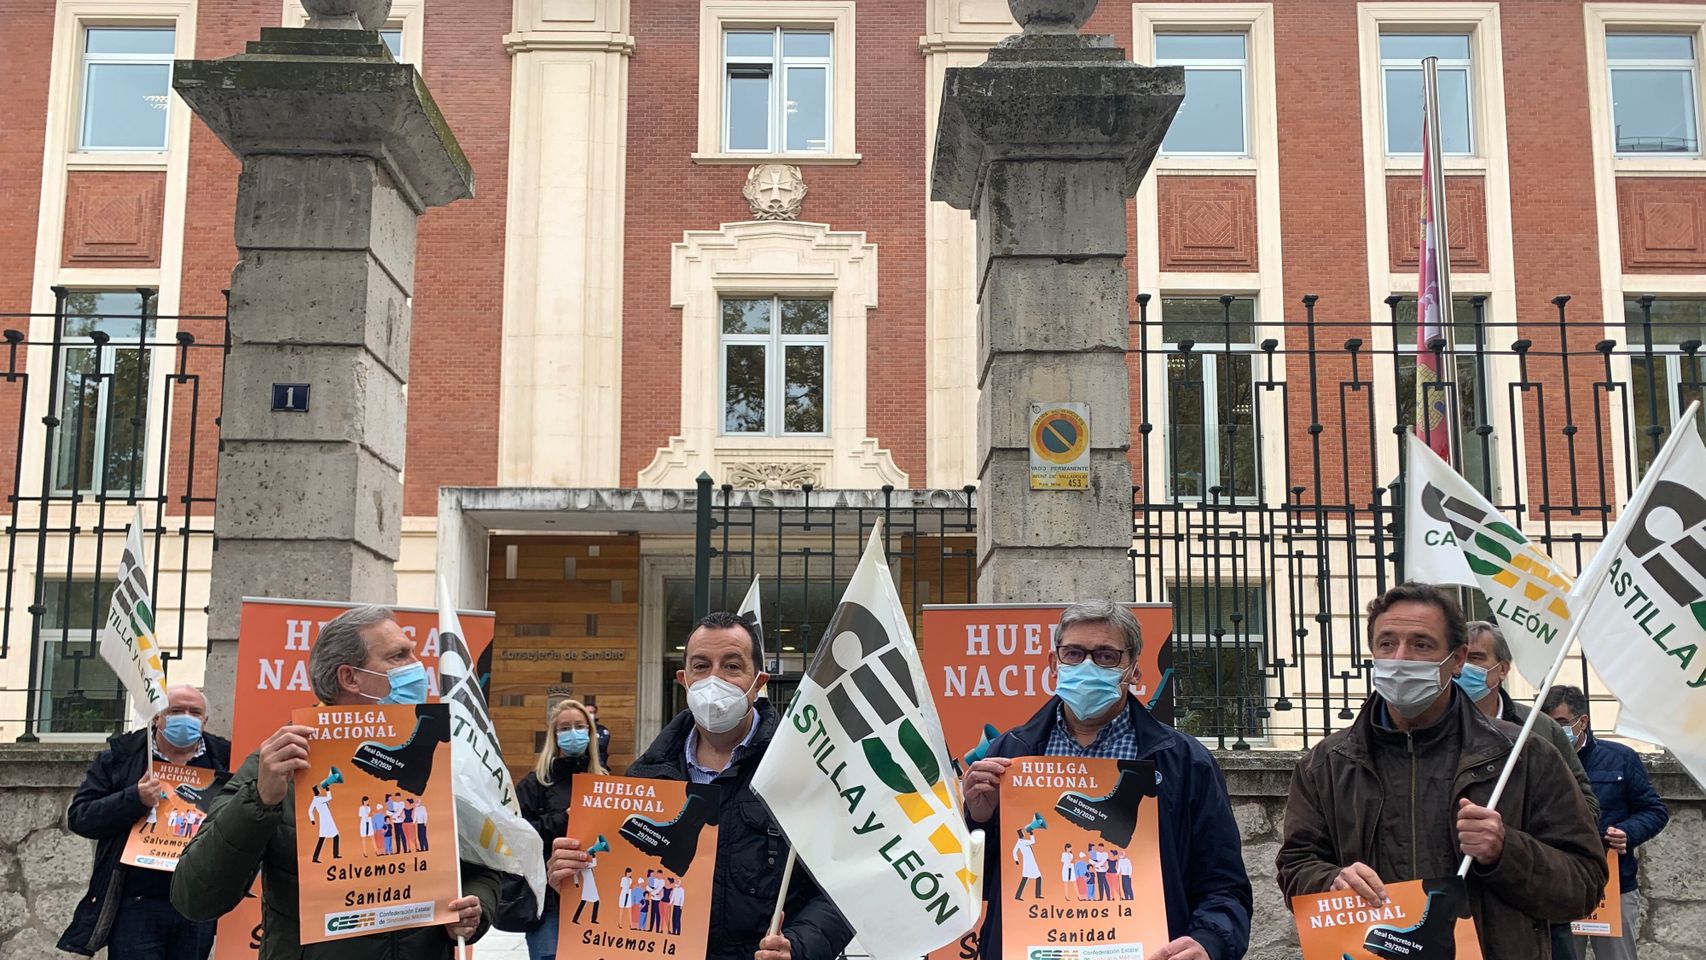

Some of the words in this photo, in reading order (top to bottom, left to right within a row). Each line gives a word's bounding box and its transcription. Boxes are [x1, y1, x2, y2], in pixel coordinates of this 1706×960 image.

[285, 387, 295, 408] 1
[1496, 598, 1559, 645] LEÓN
[1608, 557, 1699, 671] ASTILLA
[109, 607, 133, 654] TILLA
[565, 650, 577, 660] de
[582, 650, 625, 660] Sanidad
[943, 665, 1146, 697] NACI
[318, 711, 386, 725] HUELGA
[309, 725, 397, 740] NACIONAL
[364, 746, 376, 755] Real
[376, 751, 395, 763] Decreto
[396, 758, 405, 768] Ley
[453, 714, 504, 790] TILLA
[160, 765, 198, 776] HUELGA
[370, 757, 393, 771] 29/2020
[1022, 762, 1088, 774] HUELGA
[152, 771, 201, 784] NACIONAL
[1012, 775, 1098, 788] NACIONAL
[593, 781, 656, 797] HUELGA
[582, 795, 665, 813] NACIONAL
[787, 688, 867, 814] ASTILLA
[878, 834, 960, 926] LEÓN
[1066, 794, 1078, 804] Real
[1078, 800, 1098, 814] Decreto
[1098, 810, 1108, 820] Ley
[1073, 806, 1095, 821] 29/2020
[631, 818, 643, 828] Real
[642, 824, 662, 839] Decreto
[661, 835, 670, 846] Ley
[637, 830, 658, 847] 29/2020
[143, 836, 187, 848] Salvemos
[149, 849, 180, 858] Sanid
[327, 863, 406, 881] Salvemos
[414, 857, 427, 872] la
[345, 885, 411, 906] Sanidad
[1317, 895, 1391, 912] HUELA
[1028, 904, 1109, 919] Salvemos
[1118, 904, 1132, 917] la
[1310, 905, 1406, 929] NACIONAL
[582, 929, 656, 953] Salvemos
[663, 939, 676, 955] la
[1047, 927, 1116, 943] Sanidad
[1373, 929, 1388, 939] Real
[1388, 933, 1412, 947] Decreto
[1412, 940, 1423, 951] Ley
[1384, 941, 1410, 955] 29/2020
